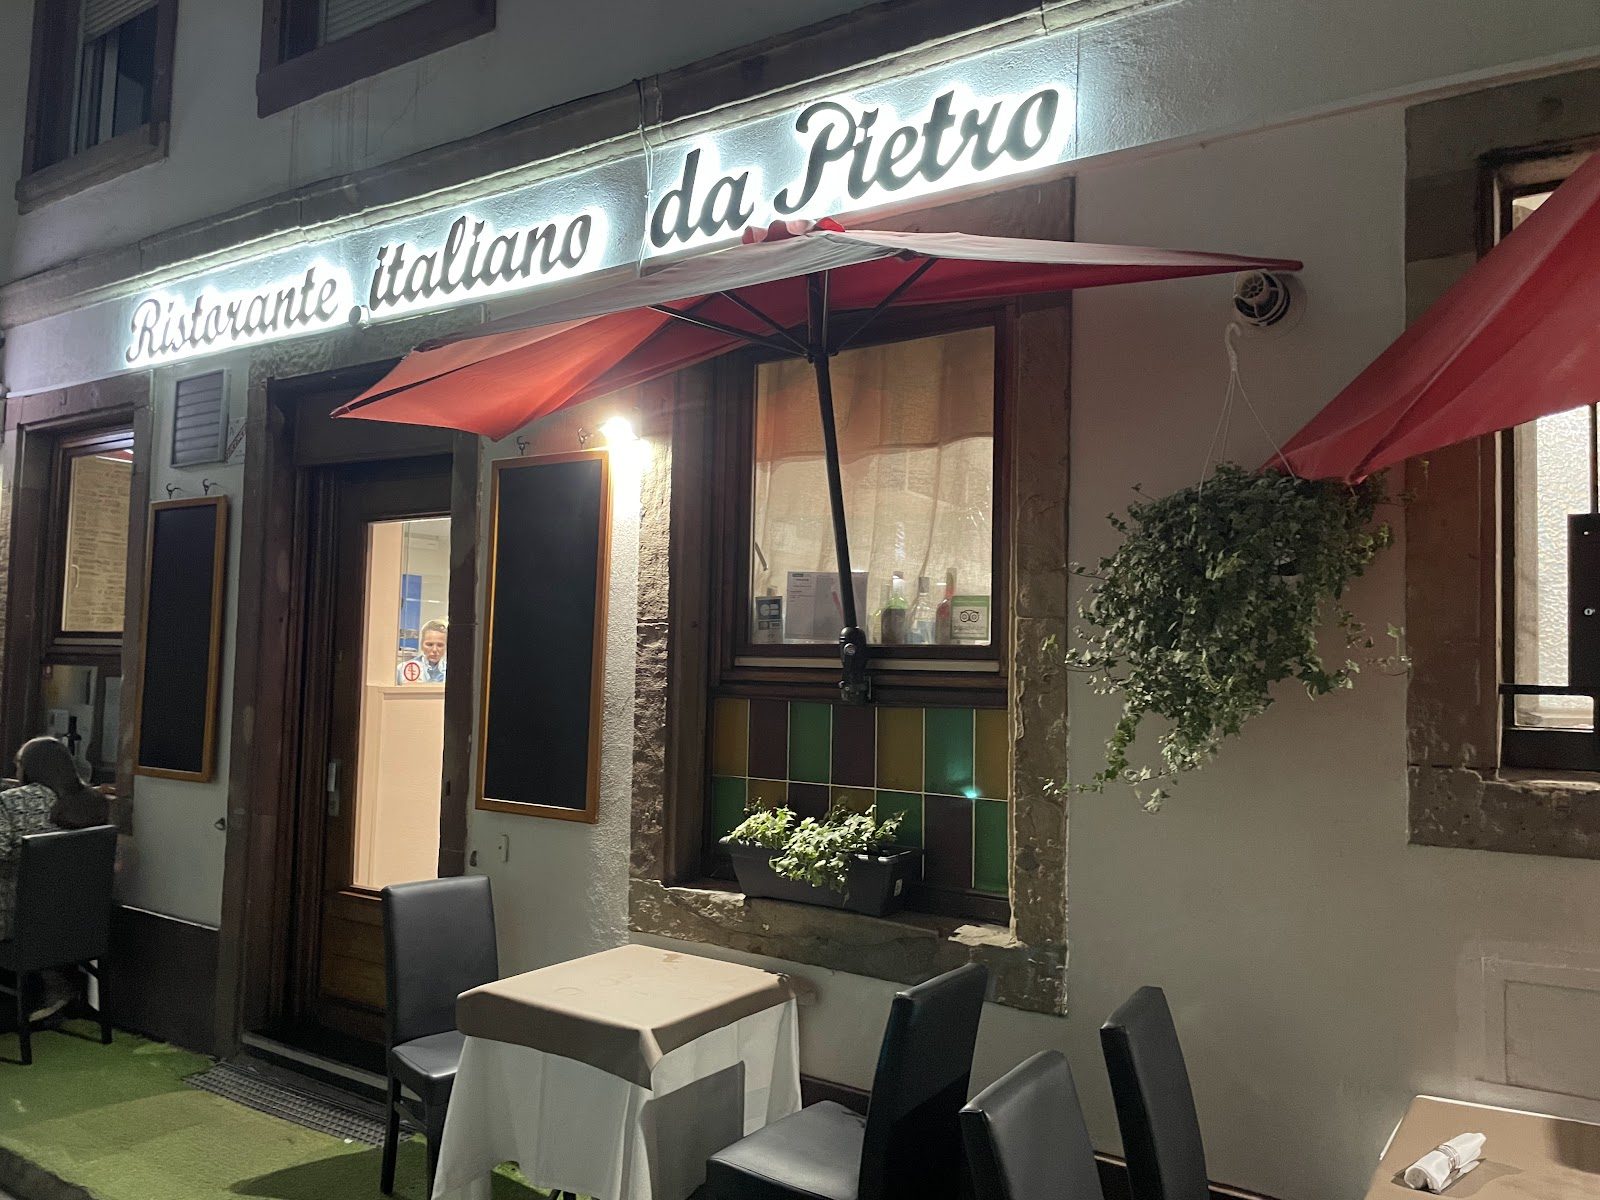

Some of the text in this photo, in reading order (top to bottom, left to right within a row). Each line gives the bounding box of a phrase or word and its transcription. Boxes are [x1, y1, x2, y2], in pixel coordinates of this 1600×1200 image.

[127, 90, 1059, 362] Ristorante italiano da Pietro
